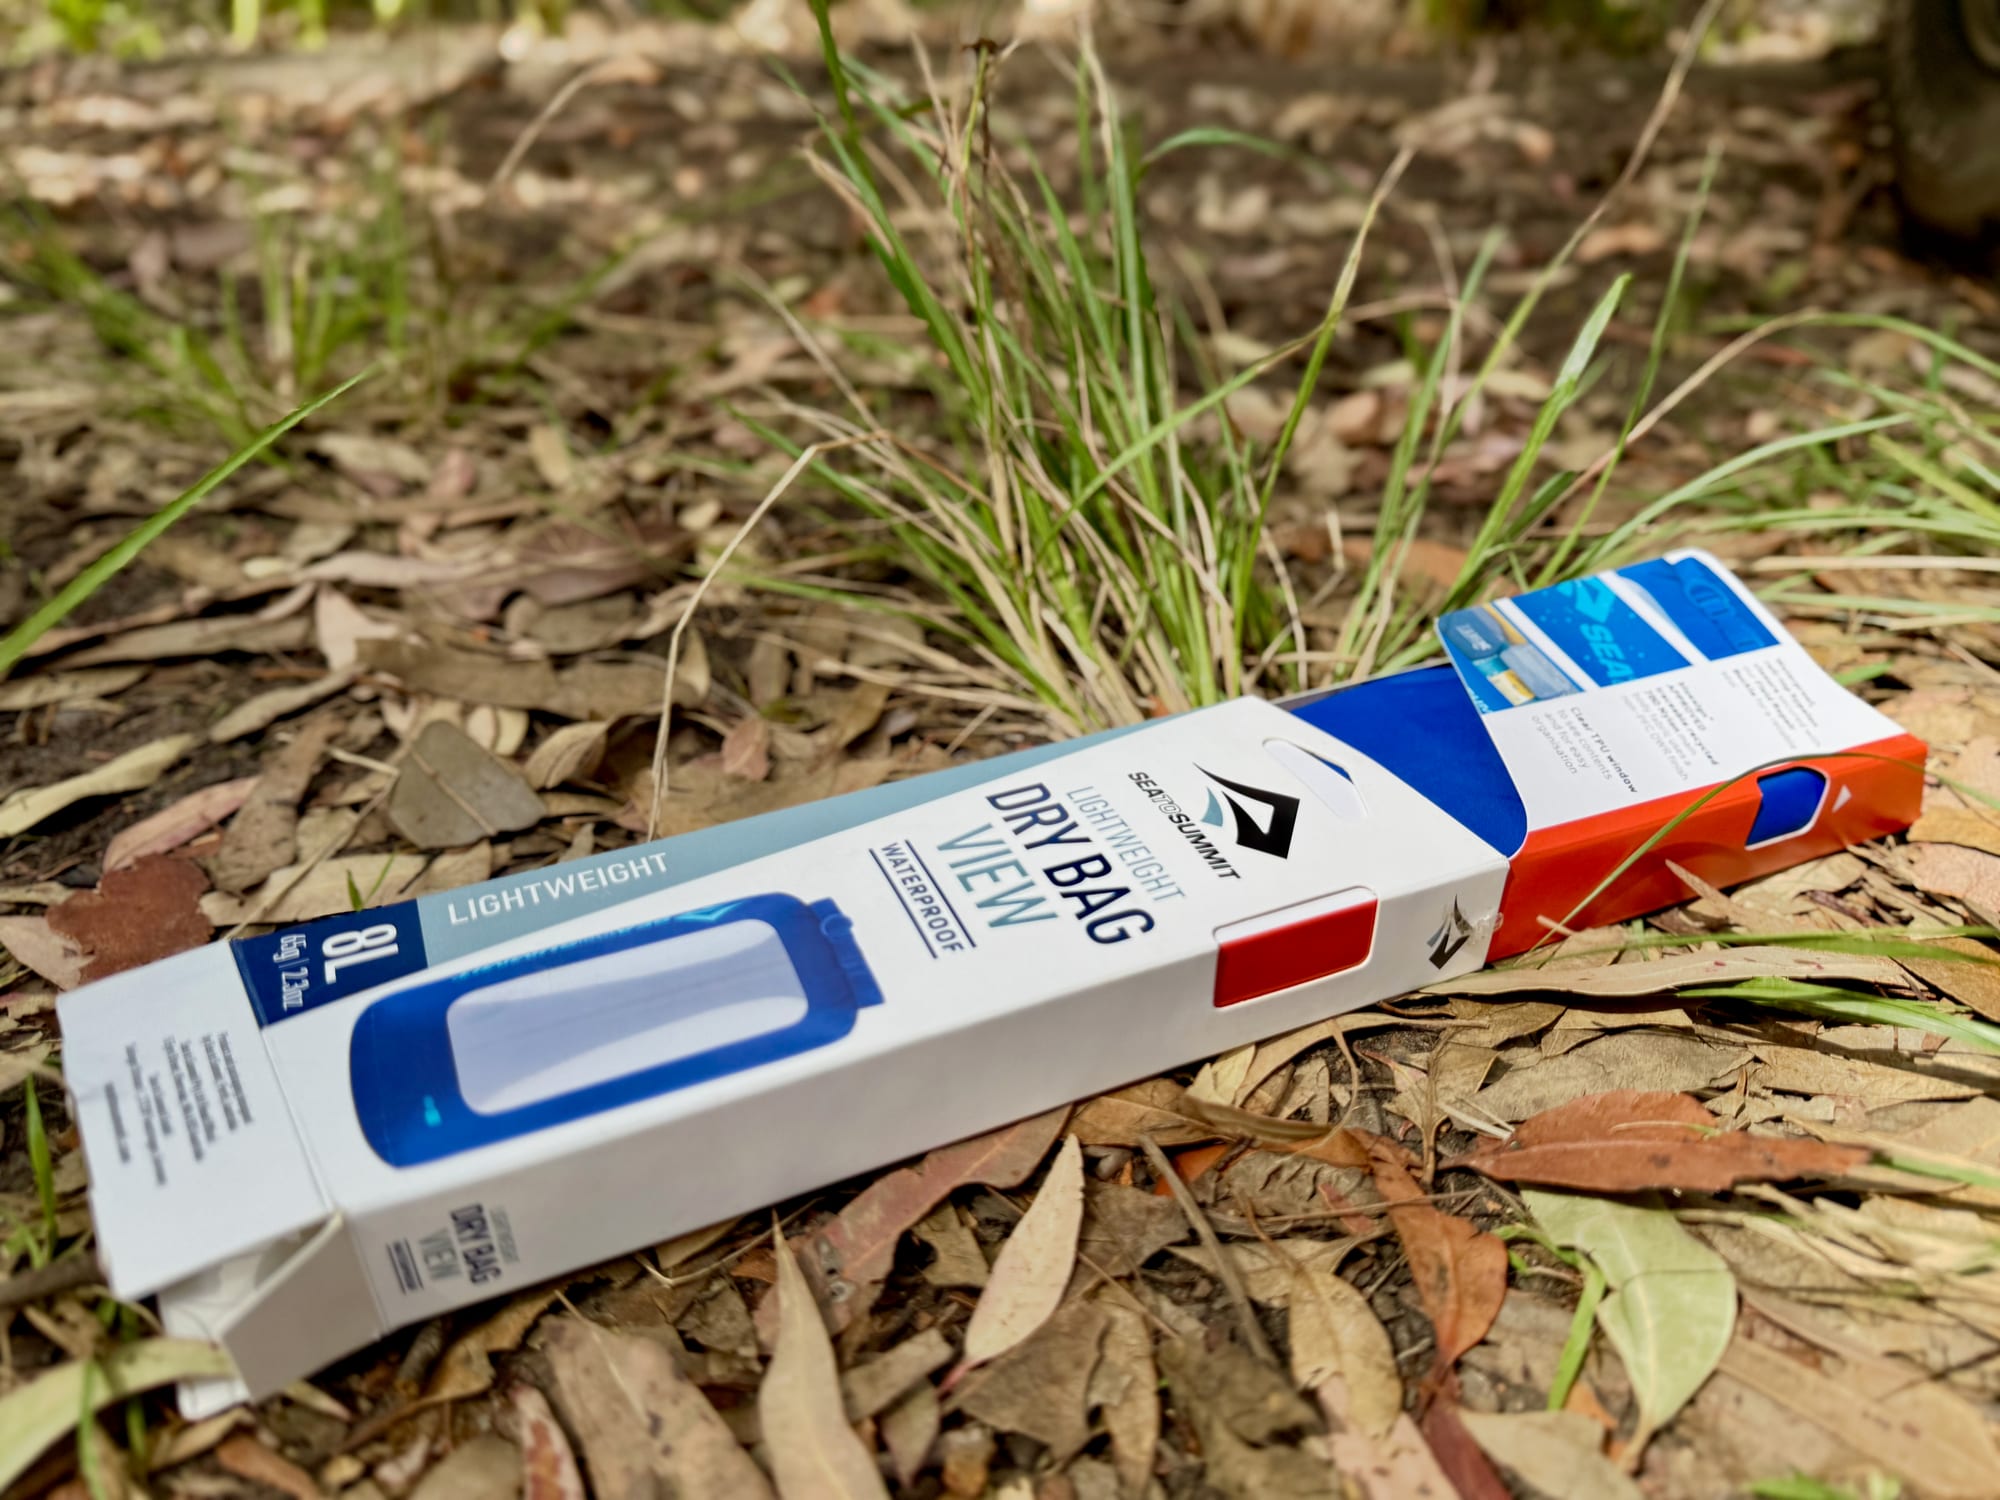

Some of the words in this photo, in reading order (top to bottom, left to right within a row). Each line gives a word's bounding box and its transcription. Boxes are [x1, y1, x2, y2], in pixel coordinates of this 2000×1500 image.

[1531, 716, 1578, 775] organisation
[1544, 712, 1564, 730] and
[1558, 730, 1574, 744] for
[1569, 746, 1590, 768] easy
[1557, 709, 1569, 720] to
[1565, 721, 1581, 737] see
[1578, 738, 1613, 781] contents
[1571, 707, 1592, 731] Clear
[1591, 733, 1611, 753] TPU
[1607, 755, 1638, 793] window
[936, 823, 1058, 928] VIEW
[985, 782, 1092, 850] DRY
[1042, 853, 1155, 944] BAG
[1066, 786, 1186, 902] LIGHTWEIGHT
[446, 851, 669, 926] LIGHTWEIGHT
[881, 842, 964, 951] WATERPROOF
[272, 933, 307, 963] 65g
[321, 923, 399, 985] 8L
